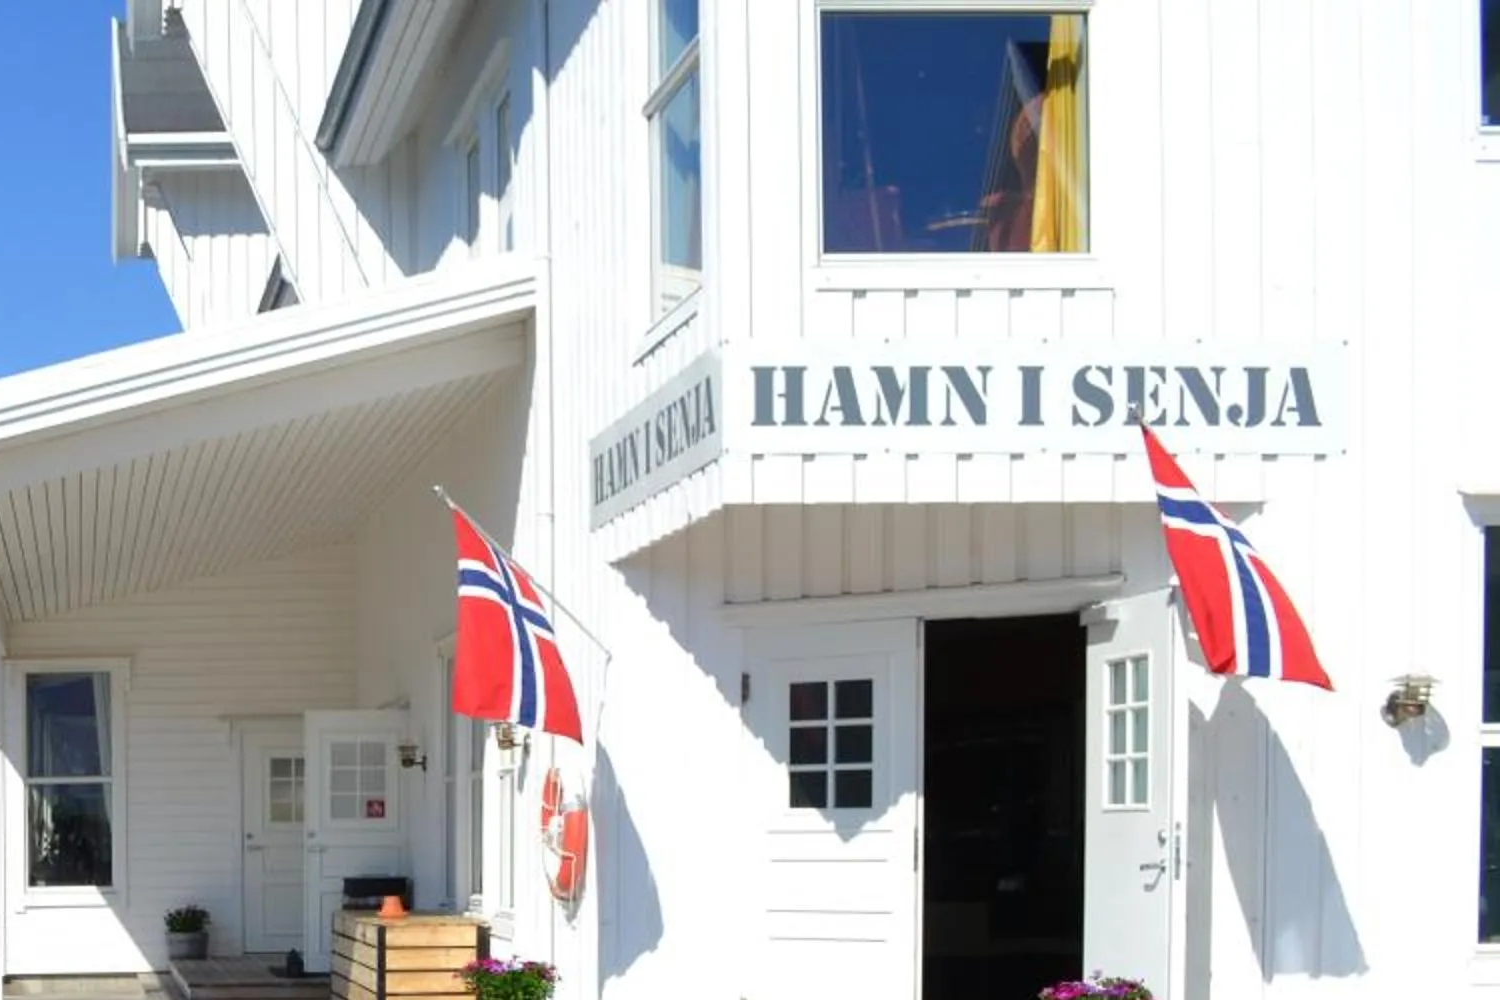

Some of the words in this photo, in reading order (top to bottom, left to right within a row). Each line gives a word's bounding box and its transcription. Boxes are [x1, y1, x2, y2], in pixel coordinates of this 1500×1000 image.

[593, 426, 640, 506] HAMN
[644, 419, 651, 475] I
[655, 375, 716, 468] SENJA
[750, 365, 994, 427] HAMN
[1018, 365, 1045, 427] I
[1072, 365, 1322, 428] SENJA
